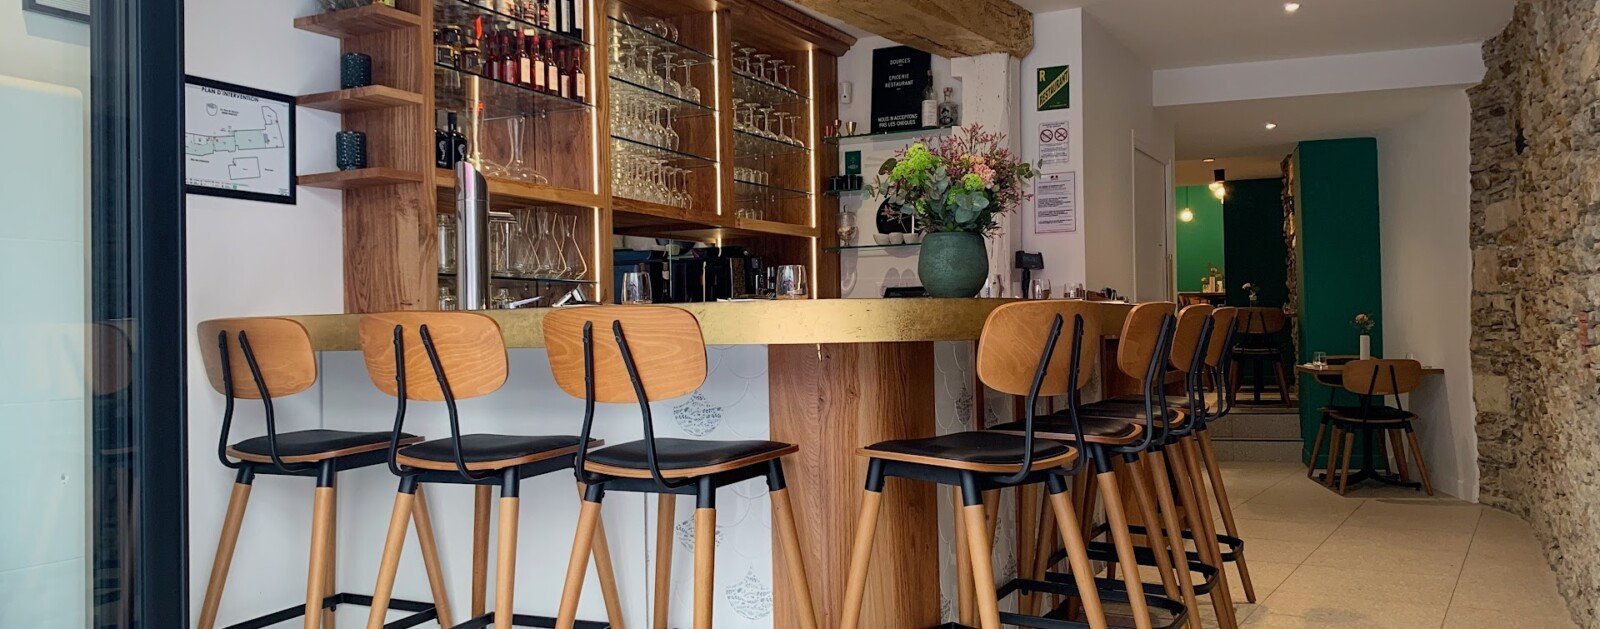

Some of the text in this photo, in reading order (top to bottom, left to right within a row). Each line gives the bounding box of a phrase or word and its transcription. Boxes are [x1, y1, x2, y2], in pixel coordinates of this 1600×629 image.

[1039, 69, 1046, 82] R
[885, 79, 913, 87] RESTAURANT
[201, 86, 216, 94] PLAN
